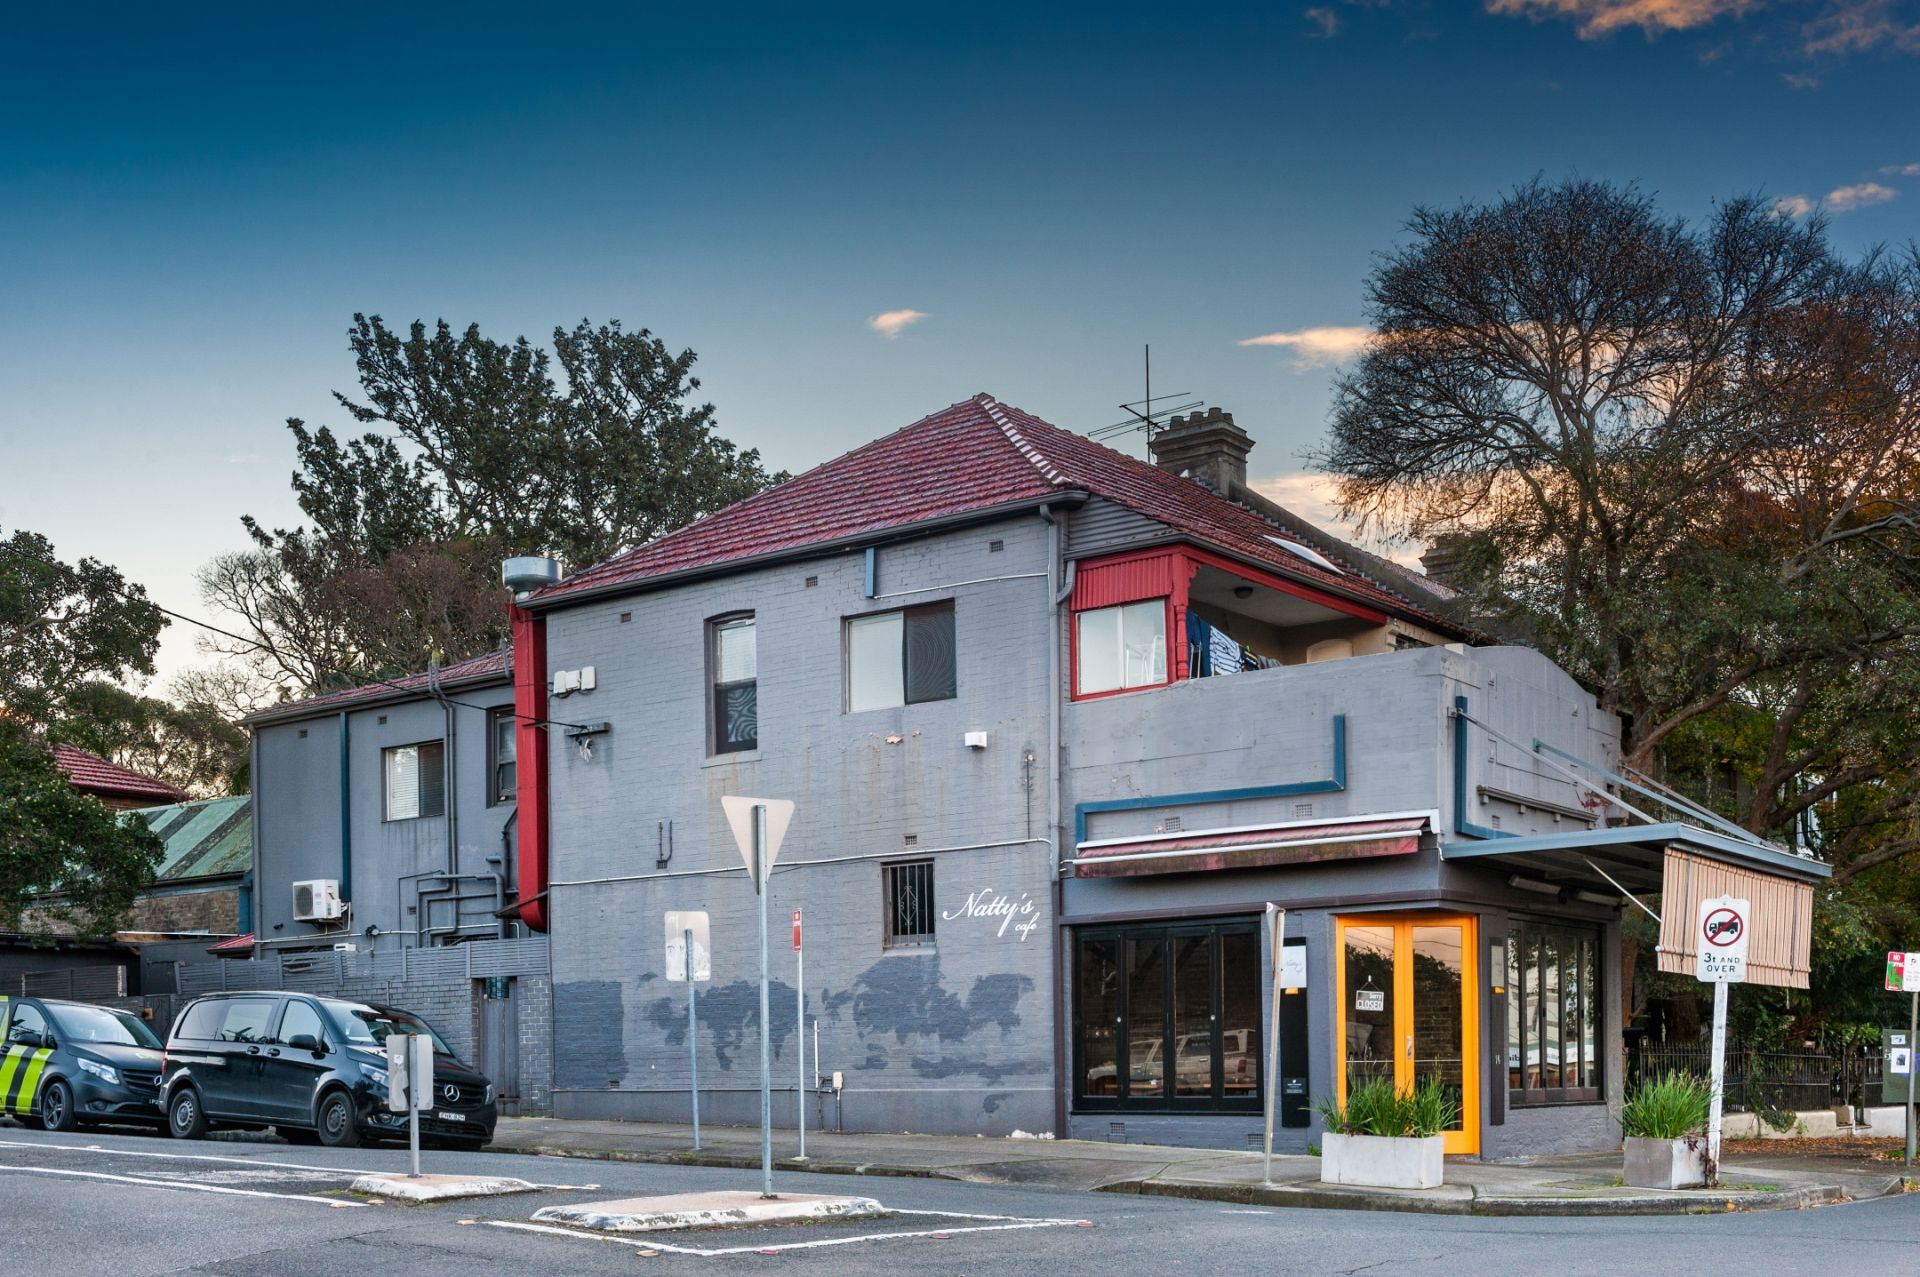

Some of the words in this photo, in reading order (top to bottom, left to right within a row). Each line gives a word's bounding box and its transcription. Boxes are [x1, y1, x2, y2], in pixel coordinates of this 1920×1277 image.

[943, 888, 1034, 937] Natty's
[1015, 912, 1040, 941] cafe
[1703, 952, 1716, 963] 3t
[1720, 956, 1741, 964] AND
[1706, 964, 1736, 973] OVER
[1357, 1000, 1383, 1010] CLOSED
